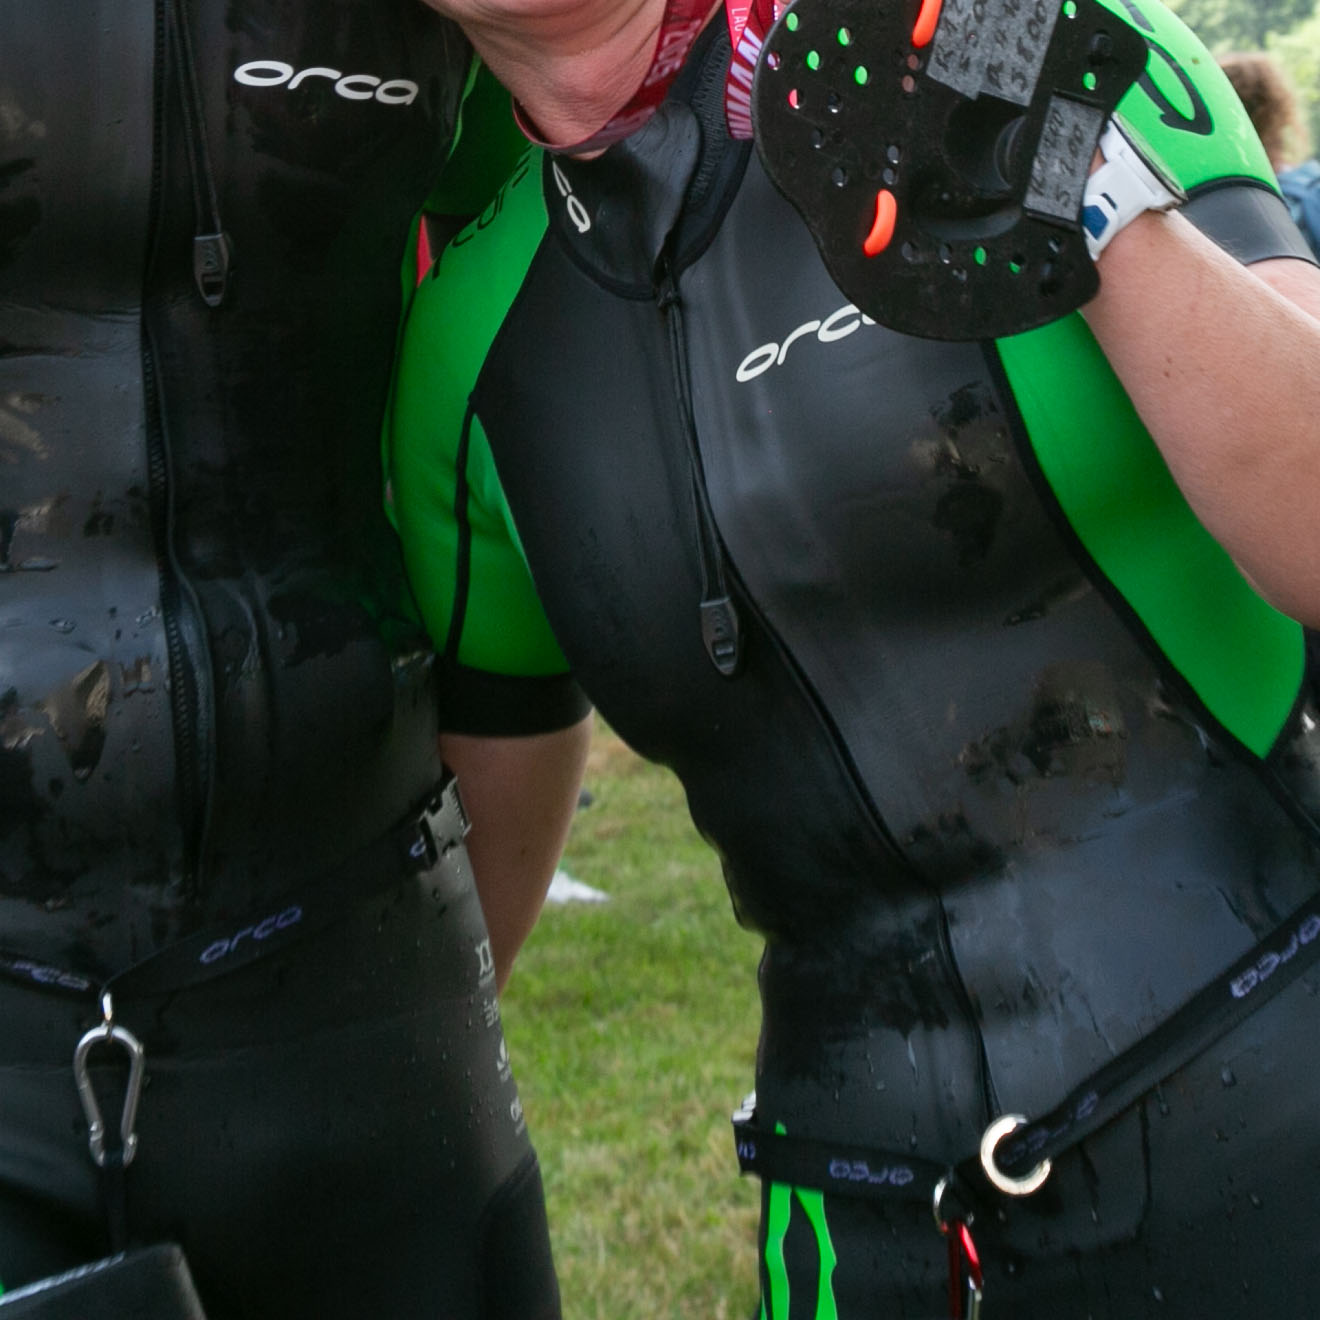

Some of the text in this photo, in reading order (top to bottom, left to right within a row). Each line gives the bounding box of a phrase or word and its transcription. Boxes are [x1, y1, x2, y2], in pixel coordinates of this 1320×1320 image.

[234, 60, 419, 106] orca
[736, 303, 877, 383] orc
[200, 906, 302, 964] orca
